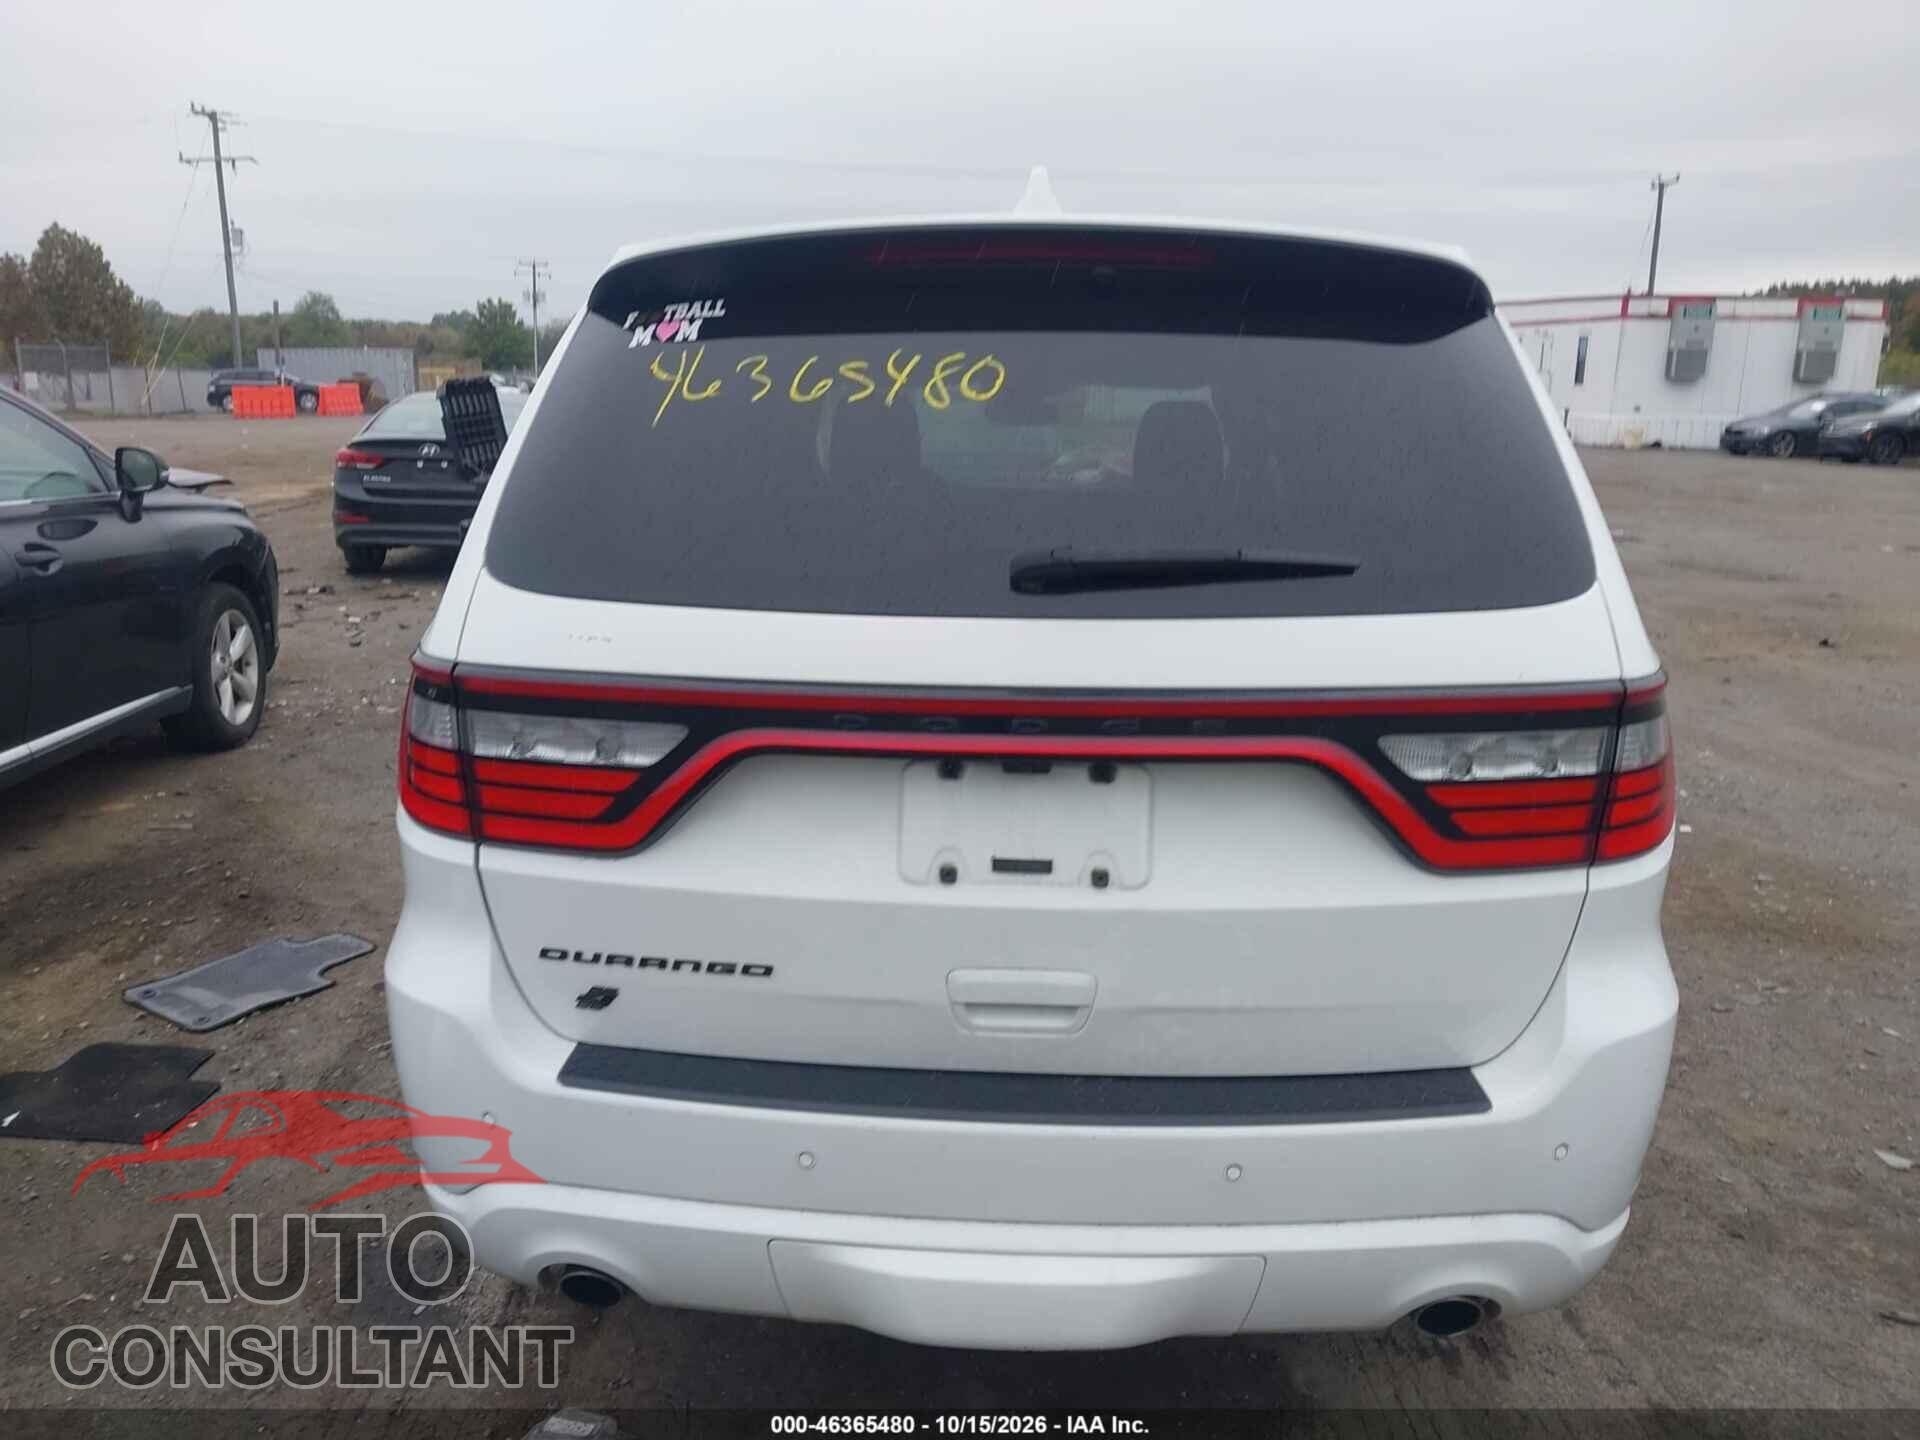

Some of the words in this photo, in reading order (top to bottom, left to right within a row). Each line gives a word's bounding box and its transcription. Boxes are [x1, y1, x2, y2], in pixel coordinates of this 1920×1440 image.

[628, 319, 703, 348] MM
[650, 344, 1006, 428] 46365480
[539, 947, 774, 977] DURANGO
